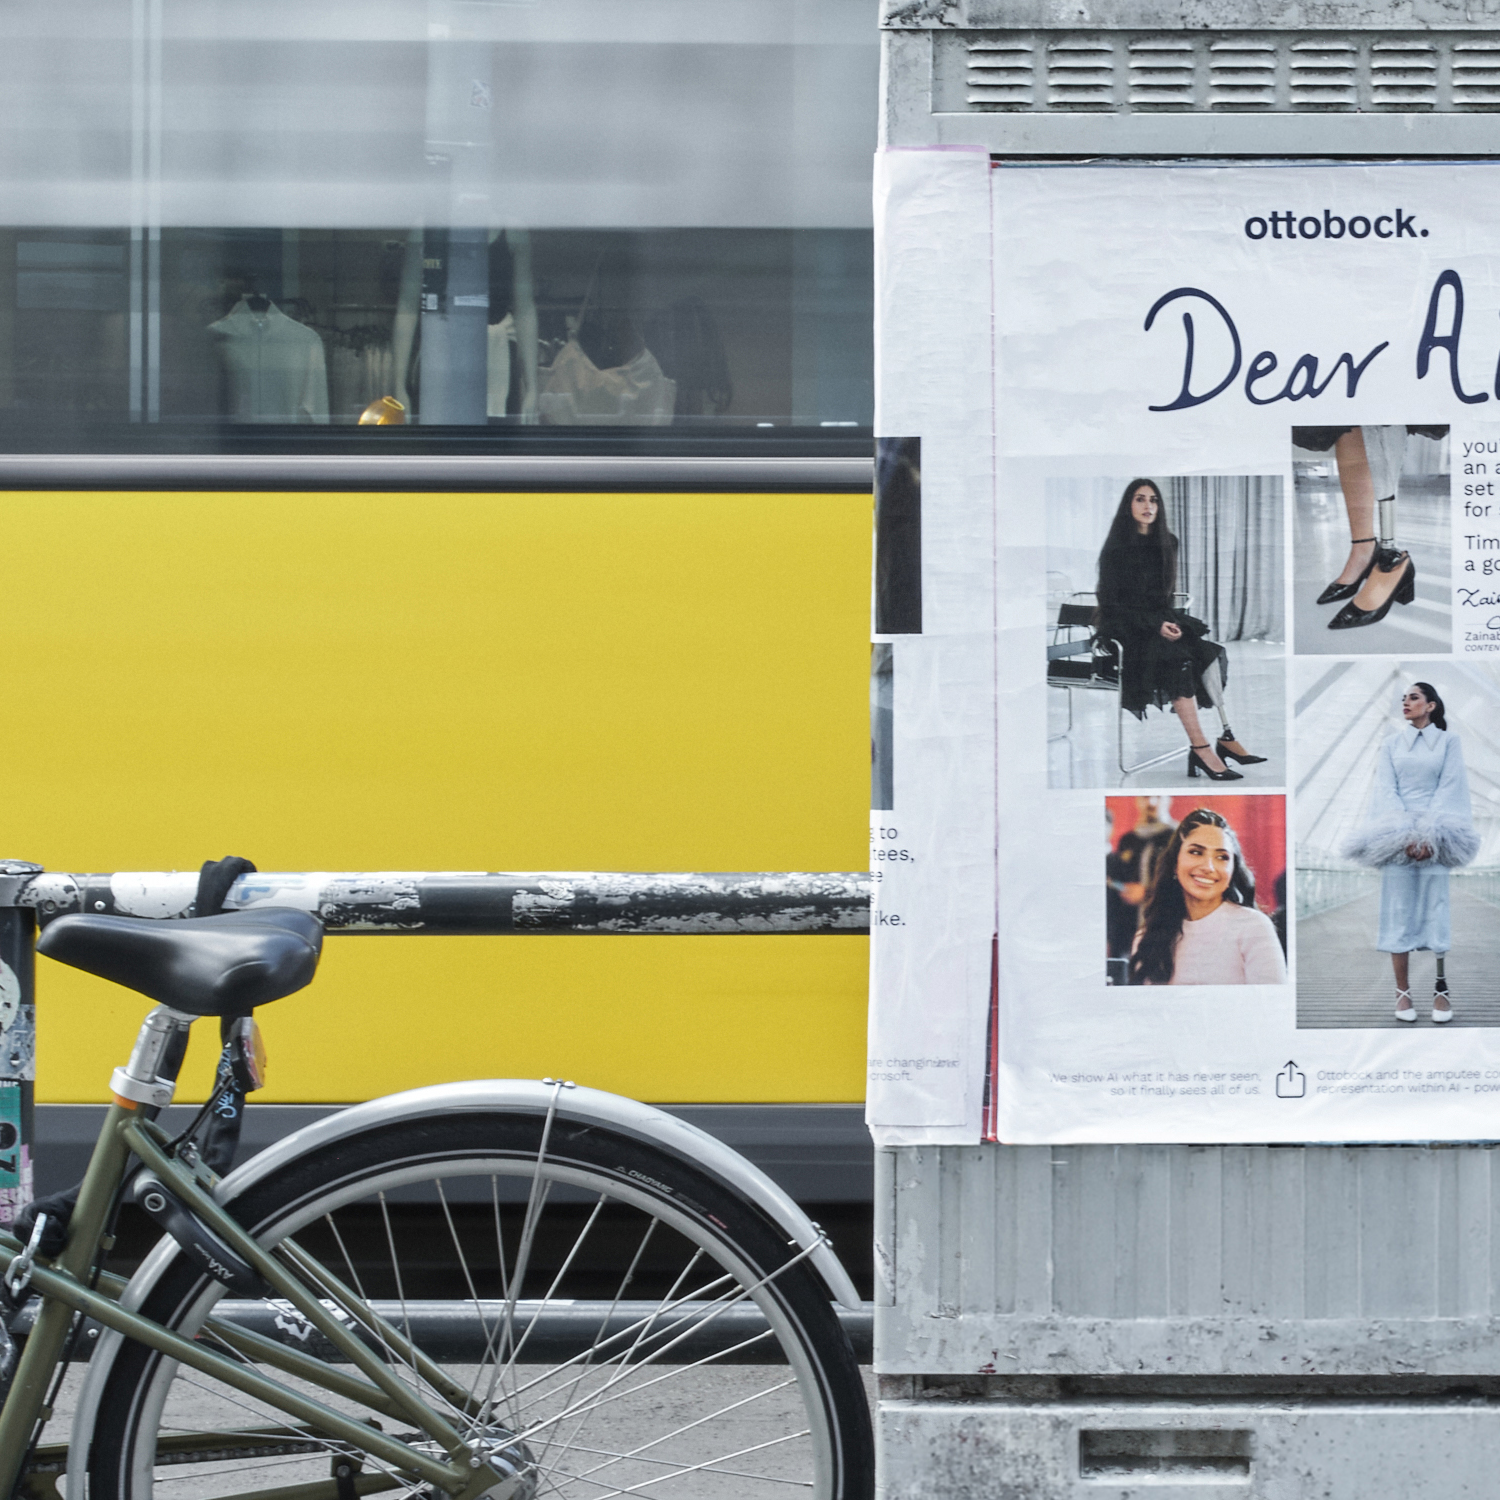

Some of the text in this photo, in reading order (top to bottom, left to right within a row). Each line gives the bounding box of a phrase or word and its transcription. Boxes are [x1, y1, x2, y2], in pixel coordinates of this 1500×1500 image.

[1245, 208, 1429, 240] ottobock.
[1143, 287, 1390, 412] Dear
[1464, 463, 1486, 475] an
[1464, 482, 1494, 496] set
[1464, 501, 1492, 517] for
[1465, 560, 1475, 571] a
[880, 827, 898, 839] to
[872, 848, 915, 863] tees,
[869, 1070, 913, 1081] crosoft.
[628, 1169, 674, 1193] CHAOYANG
